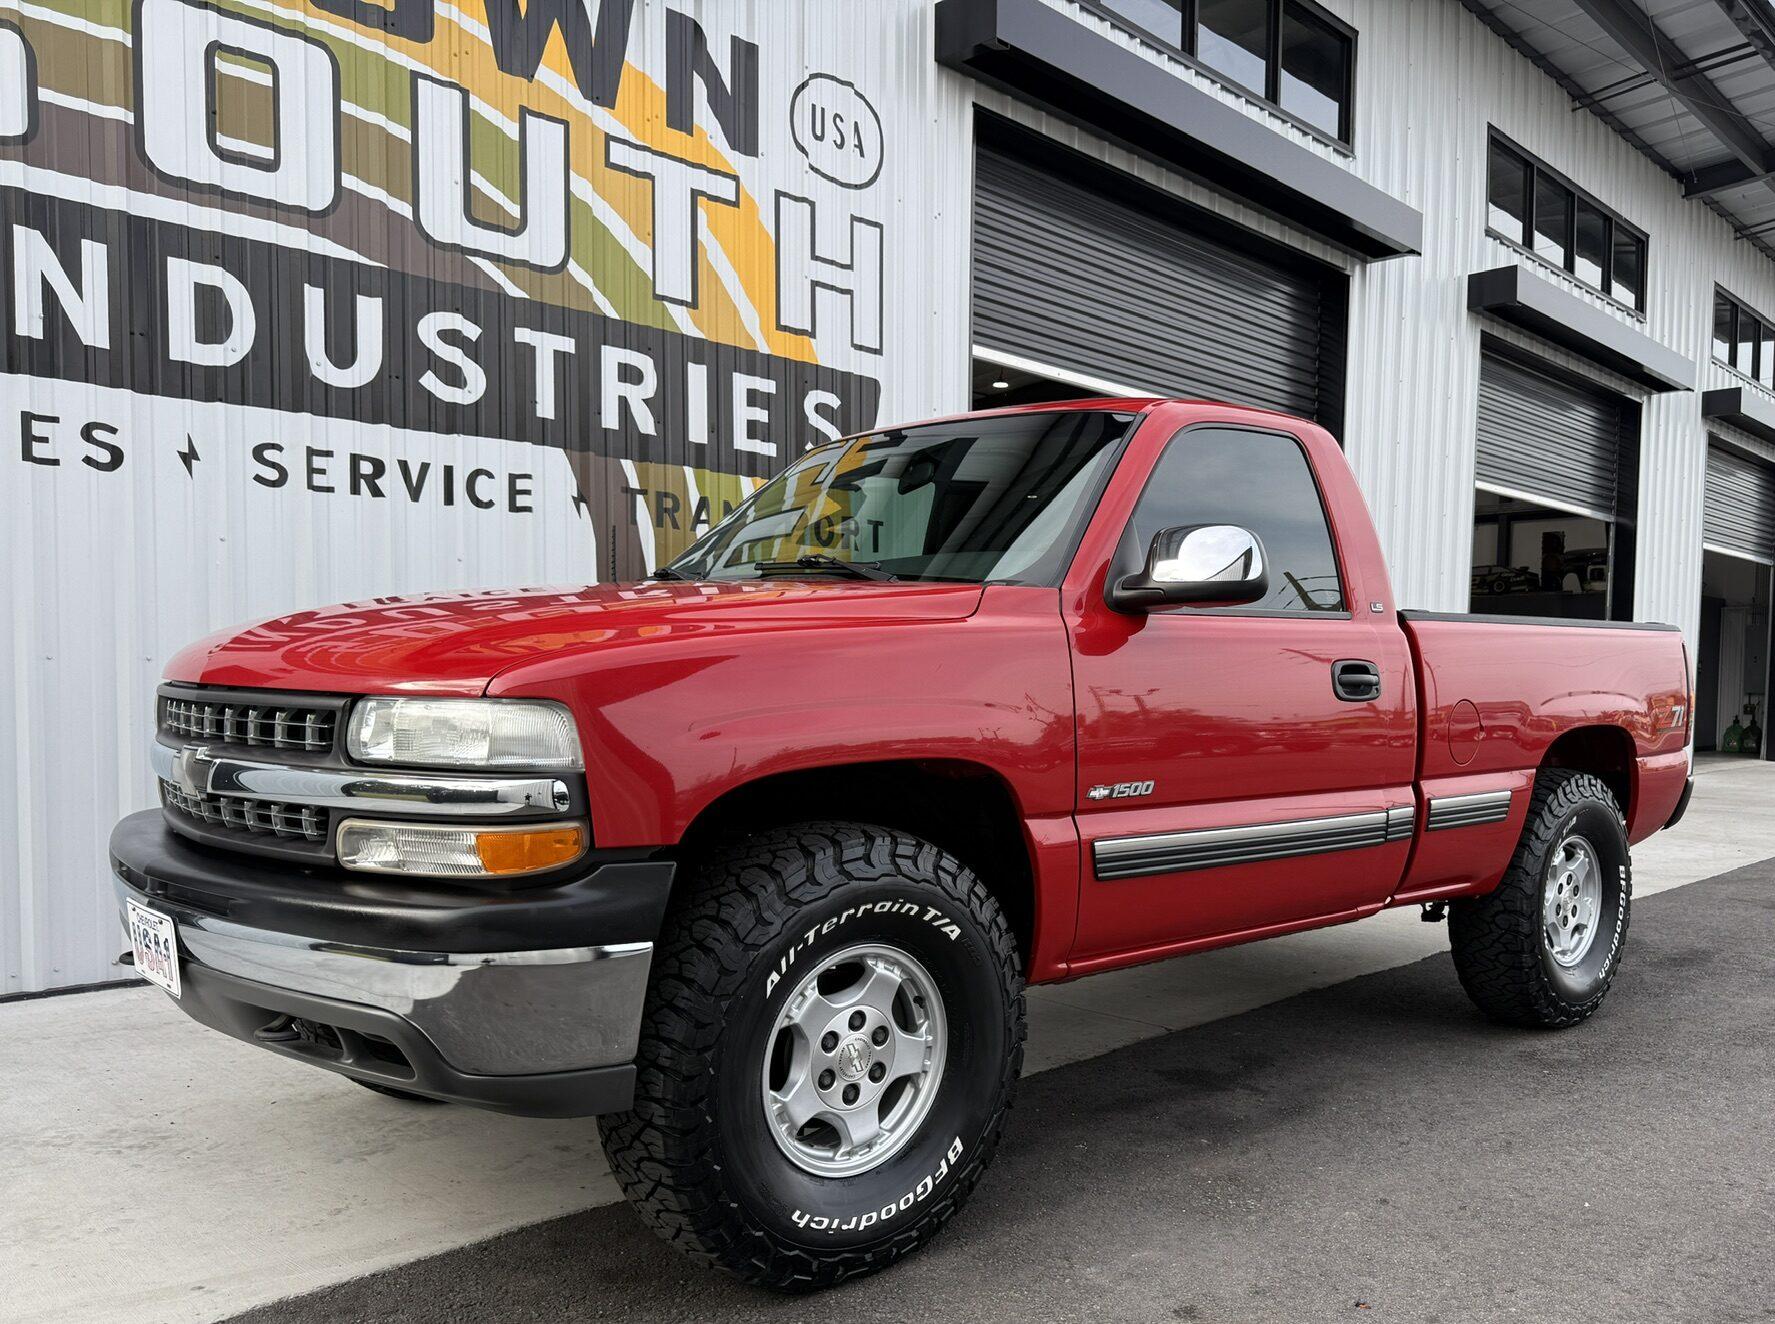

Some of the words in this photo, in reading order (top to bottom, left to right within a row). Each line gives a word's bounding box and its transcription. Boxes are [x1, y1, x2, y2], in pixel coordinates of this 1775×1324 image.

[308, 0, 759, 158] WN
[0, 0, 883, 356] OUTH
[811, 103, 865, 158] USA
[21, 411, 126, 471] ES
[253, 441, 534, 513] SERVICE
[1110, 779, 1155, 798] 1500
[766, 899, 919, 999] All-Terrain
[922, 906, 962, 941] T/A
[1599, 865, 1626, 980] BFGoodrich
[791, 1136, 964, 1234] BFGoodrich
